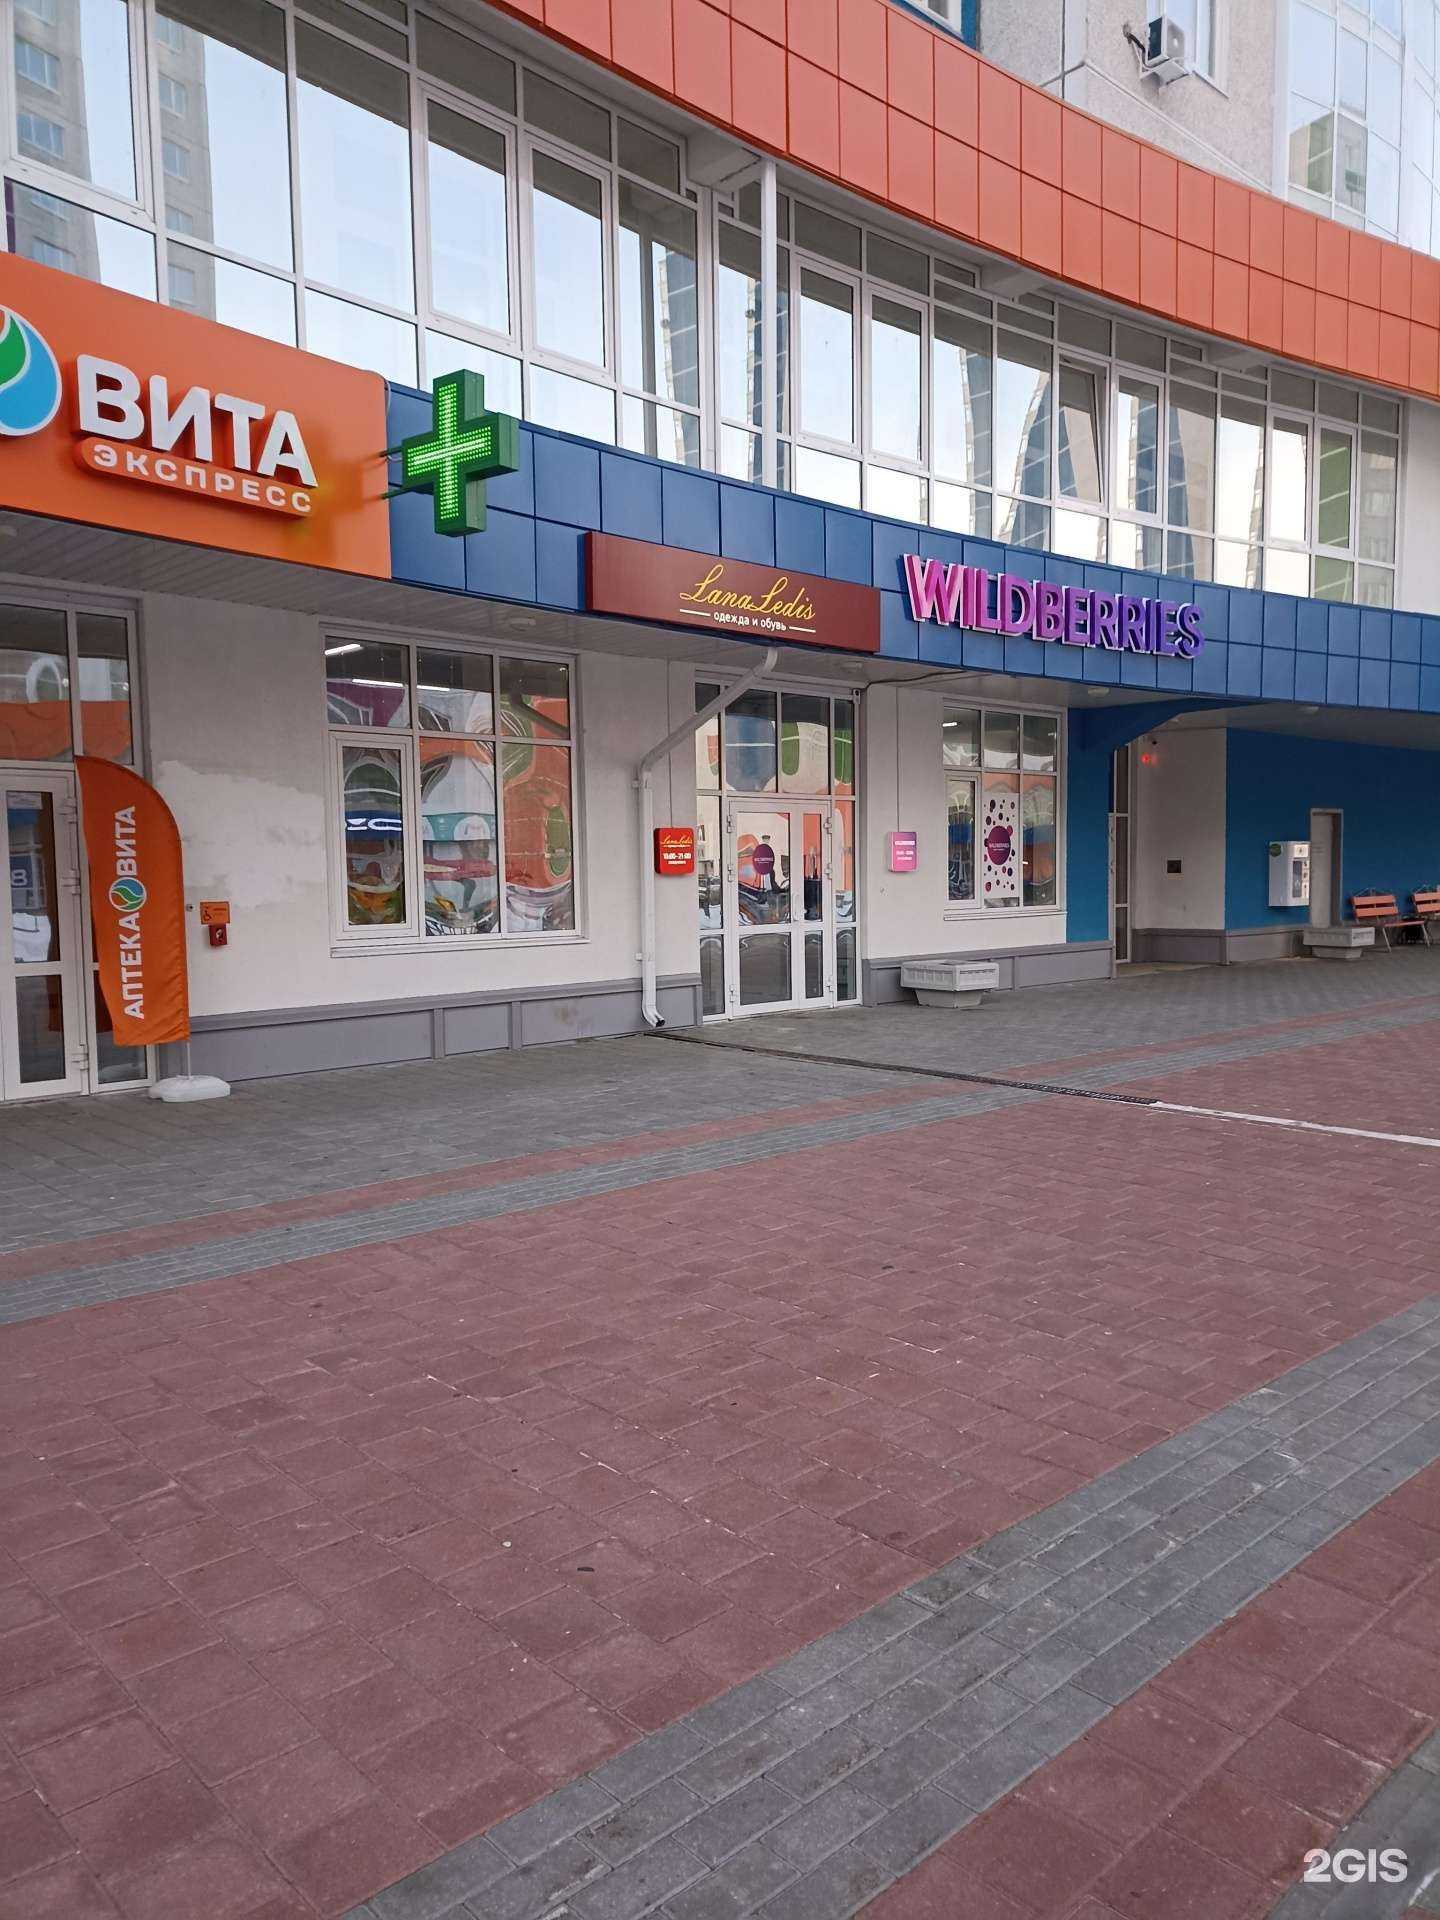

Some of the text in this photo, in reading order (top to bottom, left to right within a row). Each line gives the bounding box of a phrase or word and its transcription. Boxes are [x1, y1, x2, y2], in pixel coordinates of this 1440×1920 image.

[77, 354, 318, 487] ВИТА
[94, 444, 311, 512] ЭКСПРЕСС
[679, 564, 815, 620] Lana Ledis
[713, 611, 787, 631] одежда и обувь
[903, 553, 1204, 659] WILDBERRIES
[114, 806, 144, 1019] АПТЕКА ВИТА
